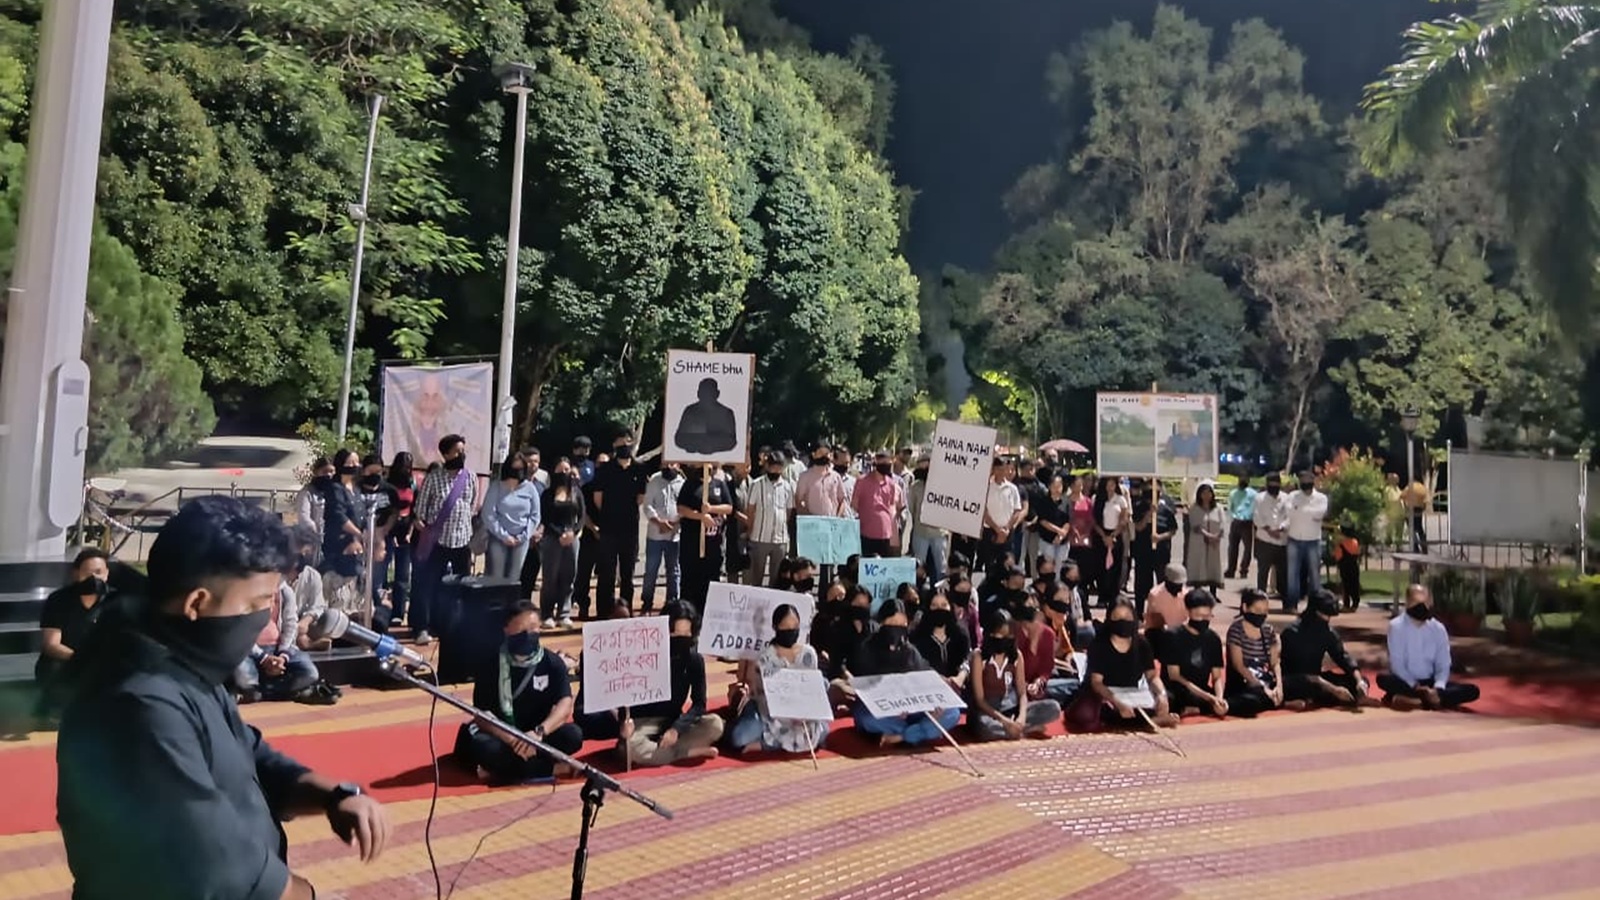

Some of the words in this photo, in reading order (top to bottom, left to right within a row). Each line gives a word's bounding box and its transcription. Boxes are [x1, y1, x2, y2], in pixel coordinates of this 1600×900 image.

[673, 360, 720, 374] SHAME
[937, 436, 964, 452] AAINA
[966, 442, 990, 457] NAHI
[926, 492, 960, 511] CHURA
[962, 500, 981, 516] LO!
[631, 688, 664, 702] TUTA
[874, 693, 946, 711] ENGINEER
